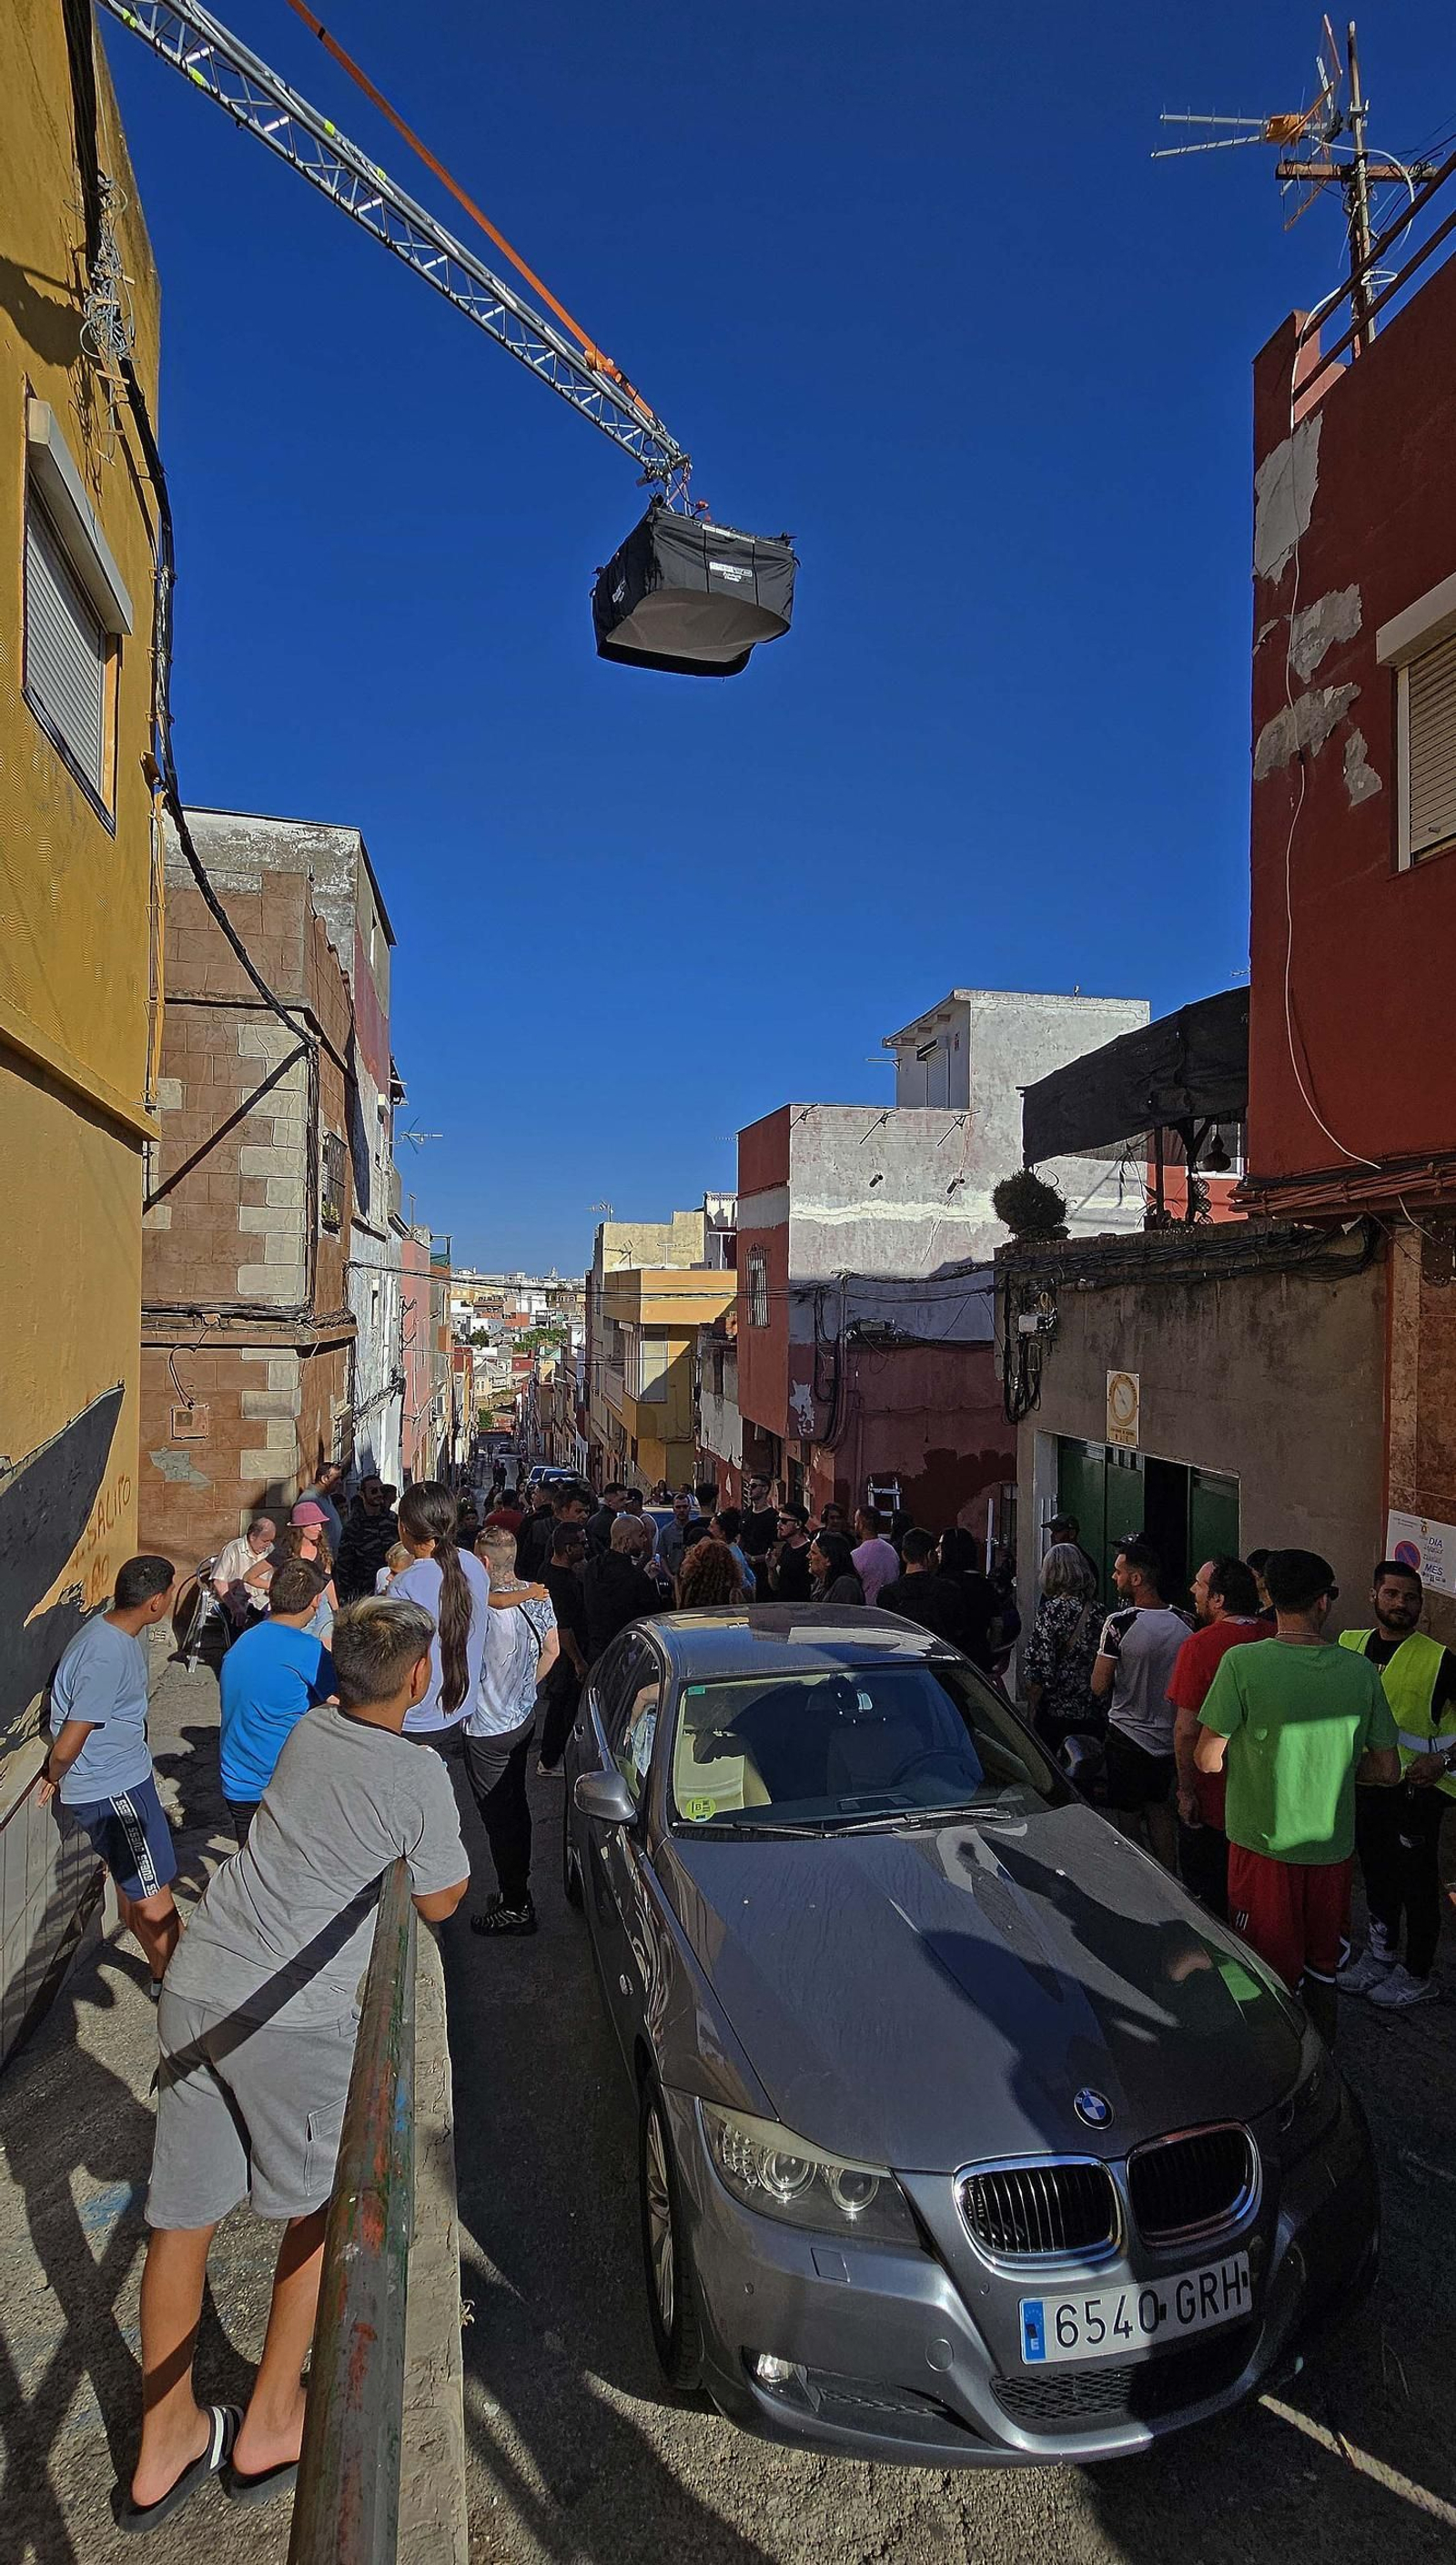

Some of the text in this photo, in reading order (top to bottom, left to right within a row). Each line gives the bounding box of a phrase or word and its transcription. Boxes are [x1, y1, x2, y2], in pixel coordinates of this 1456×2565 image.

[1429, 1537, 1443, 1548] DIA
[1424, 1563, 1444, 1577] MES
[116, 1799, 136, 1824] GUESS
[694, 1803, 703, 1811] B
[127, 1826, 145, 1852] GUESS
[137, 1854, 154, 1881] GUESS
[1056, 2261, 1242, 2349] 6540 GRH
[1030, 2337, 1040, 2351] E
